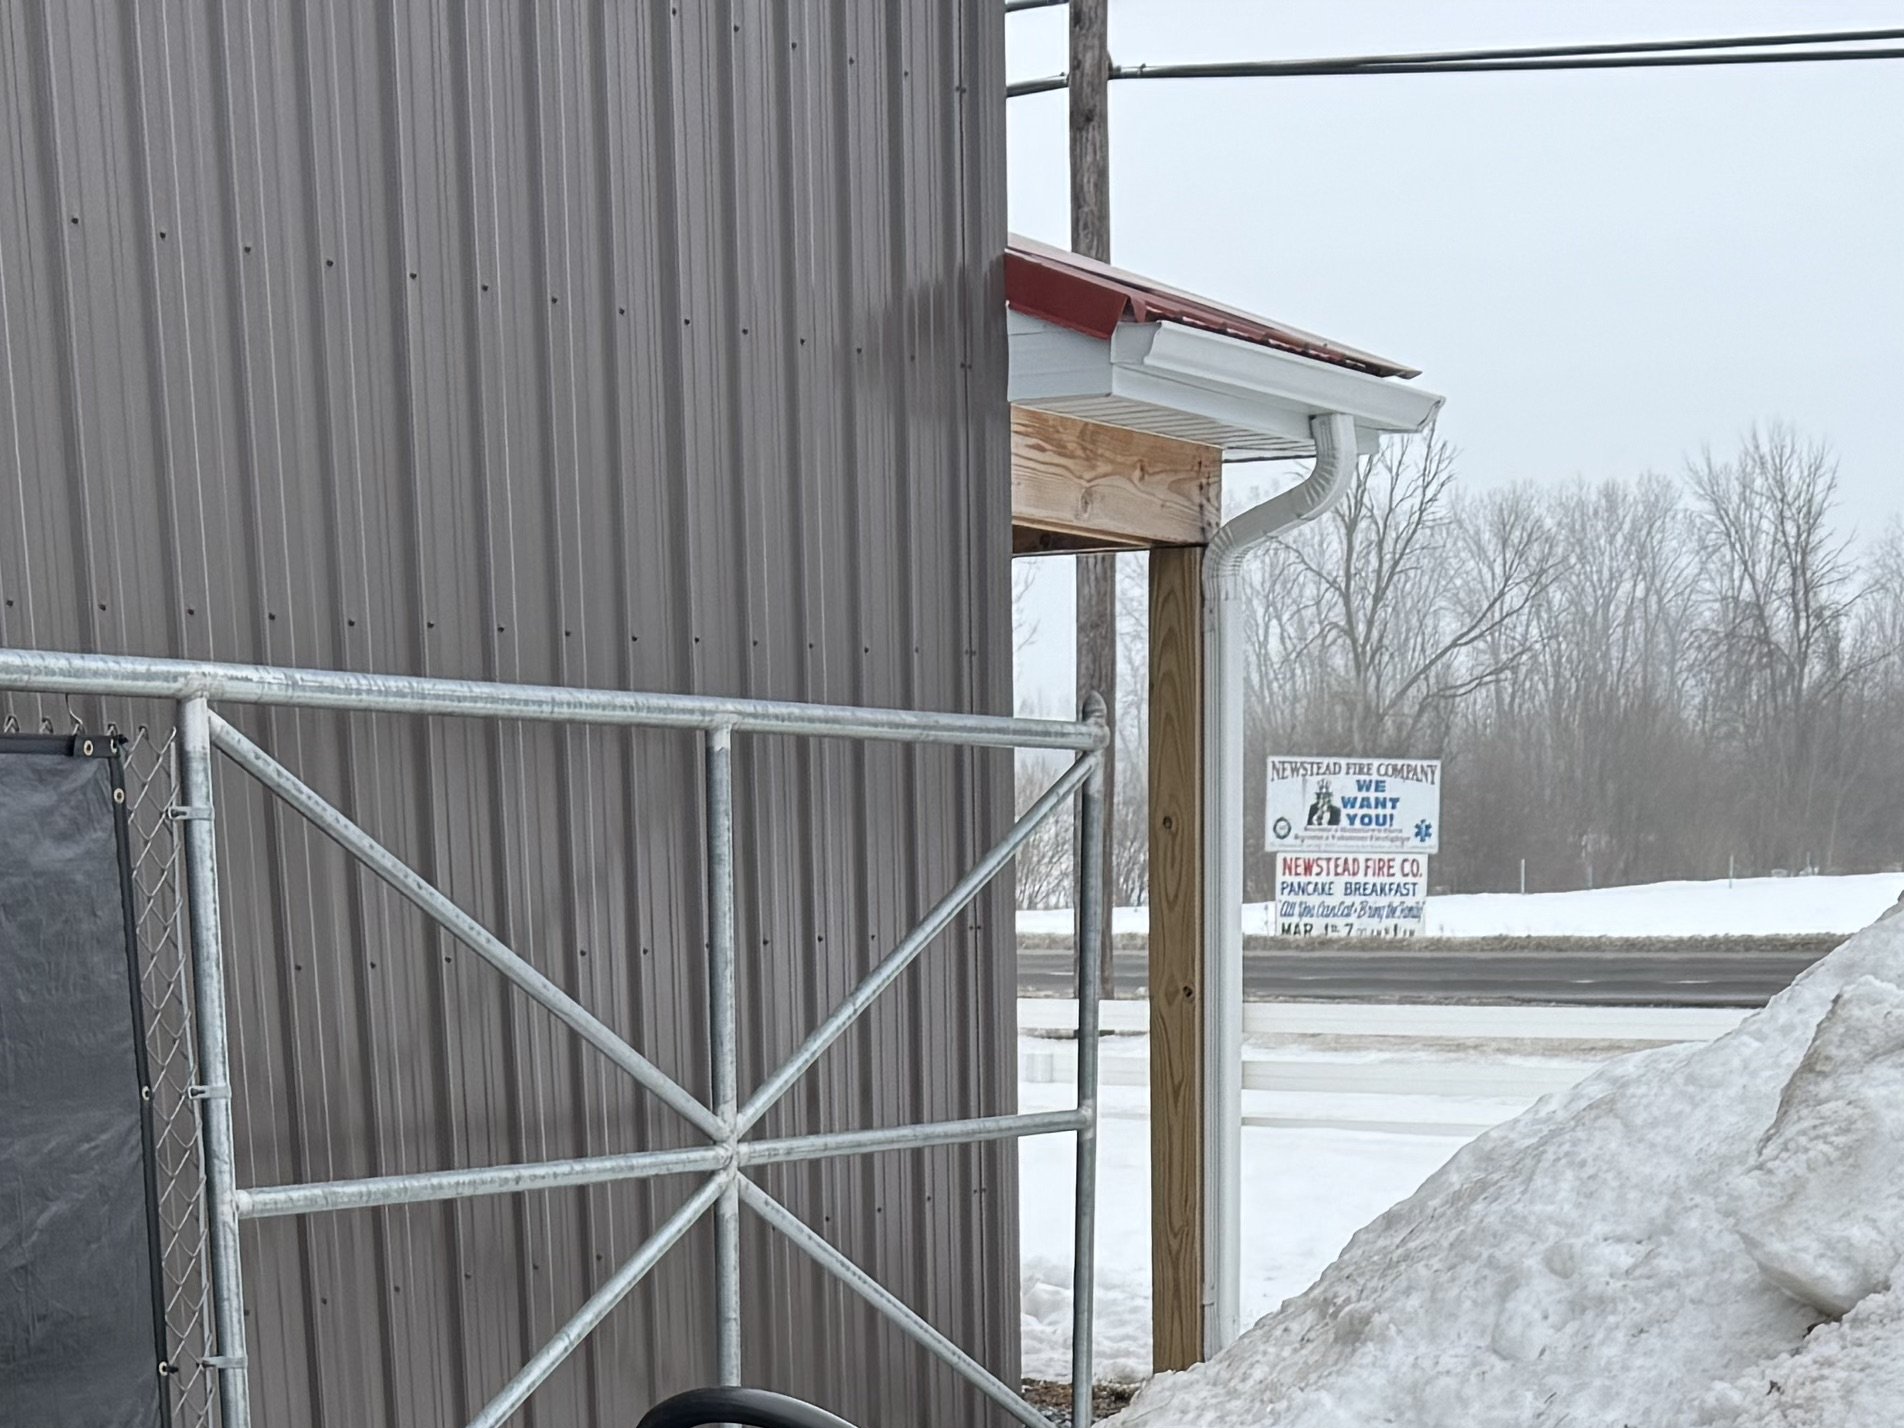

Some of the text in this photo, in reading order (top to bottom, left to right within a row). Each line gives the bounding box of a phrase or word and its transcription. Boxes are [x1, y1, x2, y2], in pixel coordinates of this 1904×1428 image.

[1271, 760, 1438, 785] NEWSTEAD FIRE COMPANY
[1355, 779, 1386, 793] WE
[1341, 796, 1400, 810] WANT
[1346, 813, 1394, 827] YOU!
[1282, 857, 1423, 878] NEWSTEAD FIRE CO.
[1280, 881, 1418, 897] PANCAKE BREAKFAST
